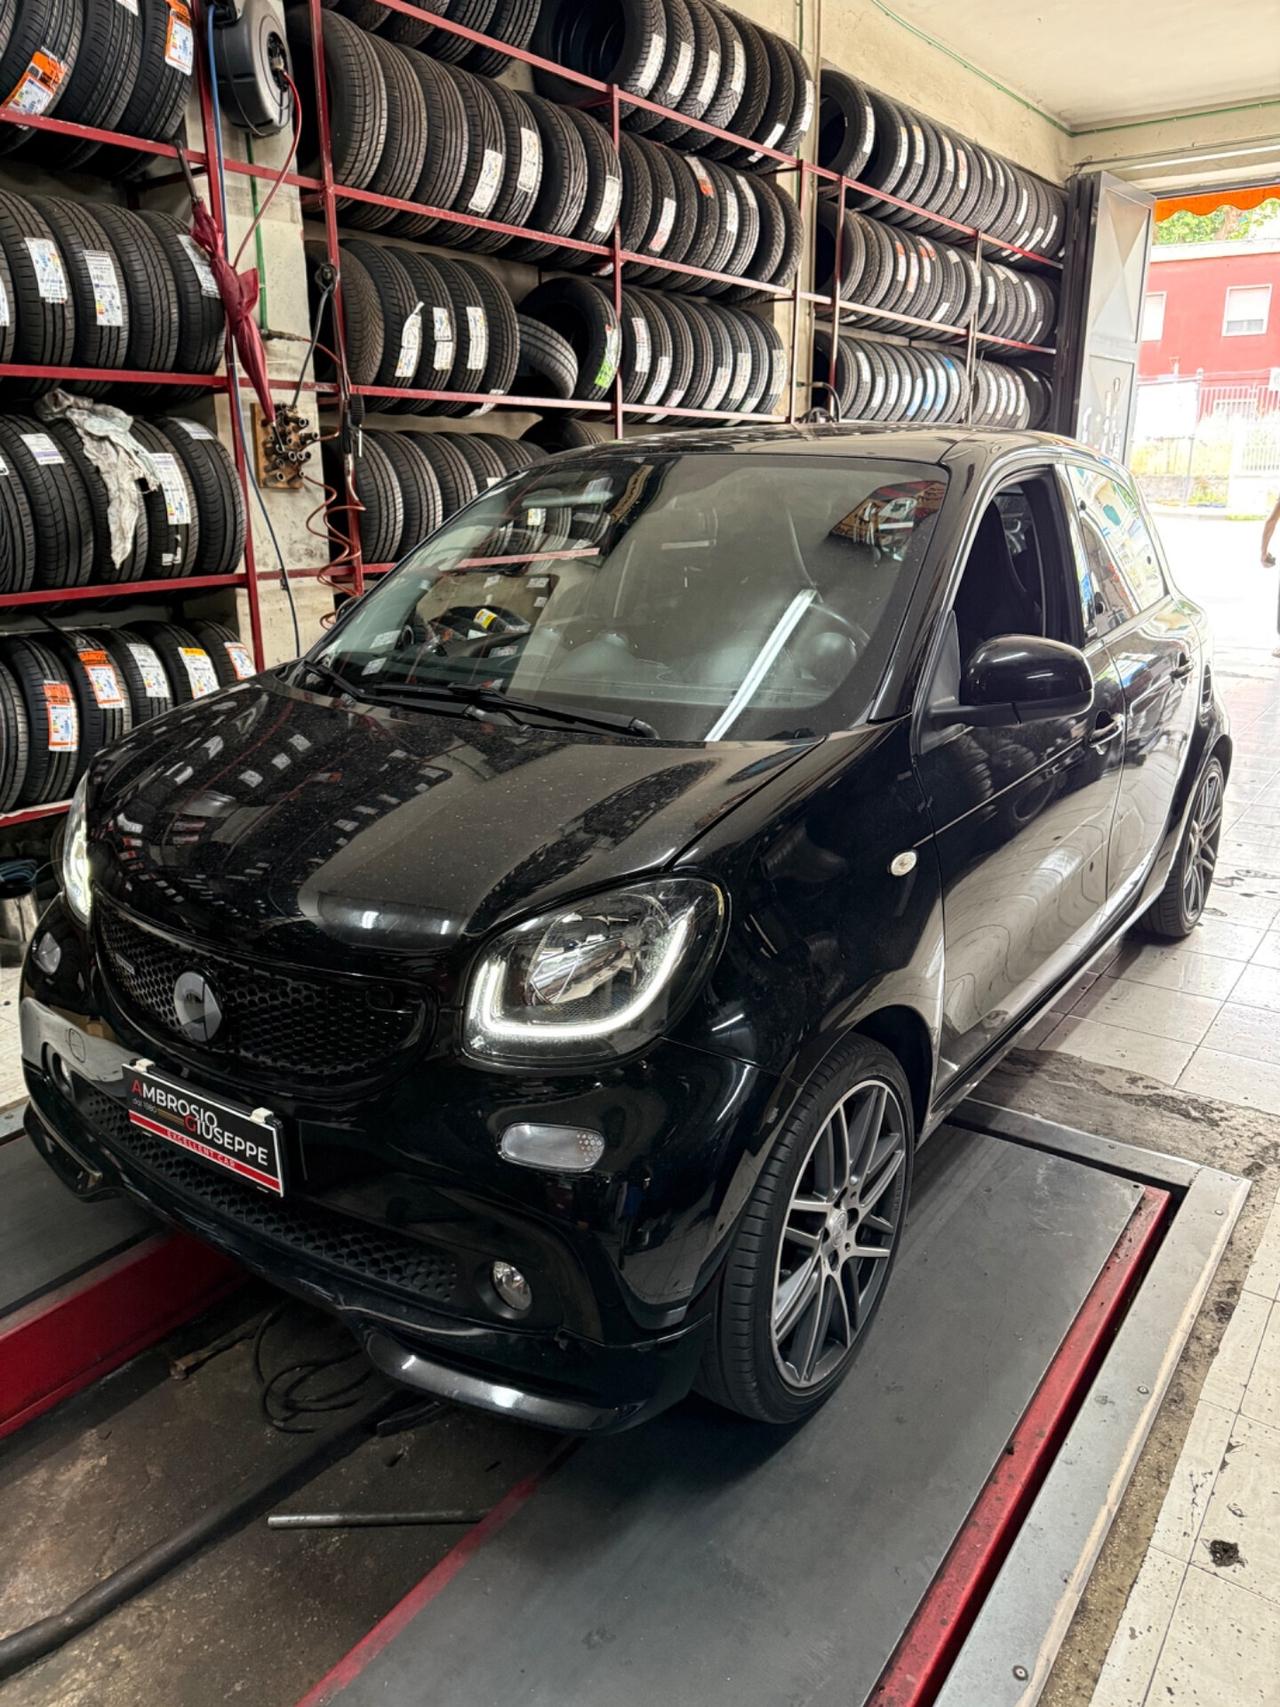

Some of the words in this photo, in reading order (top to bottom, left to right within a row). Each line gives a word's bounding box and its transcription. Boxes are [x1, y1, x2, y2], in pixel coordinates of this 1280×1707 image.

[132, 1080, 217, 1126] AMBROSIO
[167, 1131, 214, 1157] EXCELLENT
[217, 1153, 235, 1167] CAR
[184, 1115, 268, 1166] GIUSEPPE
